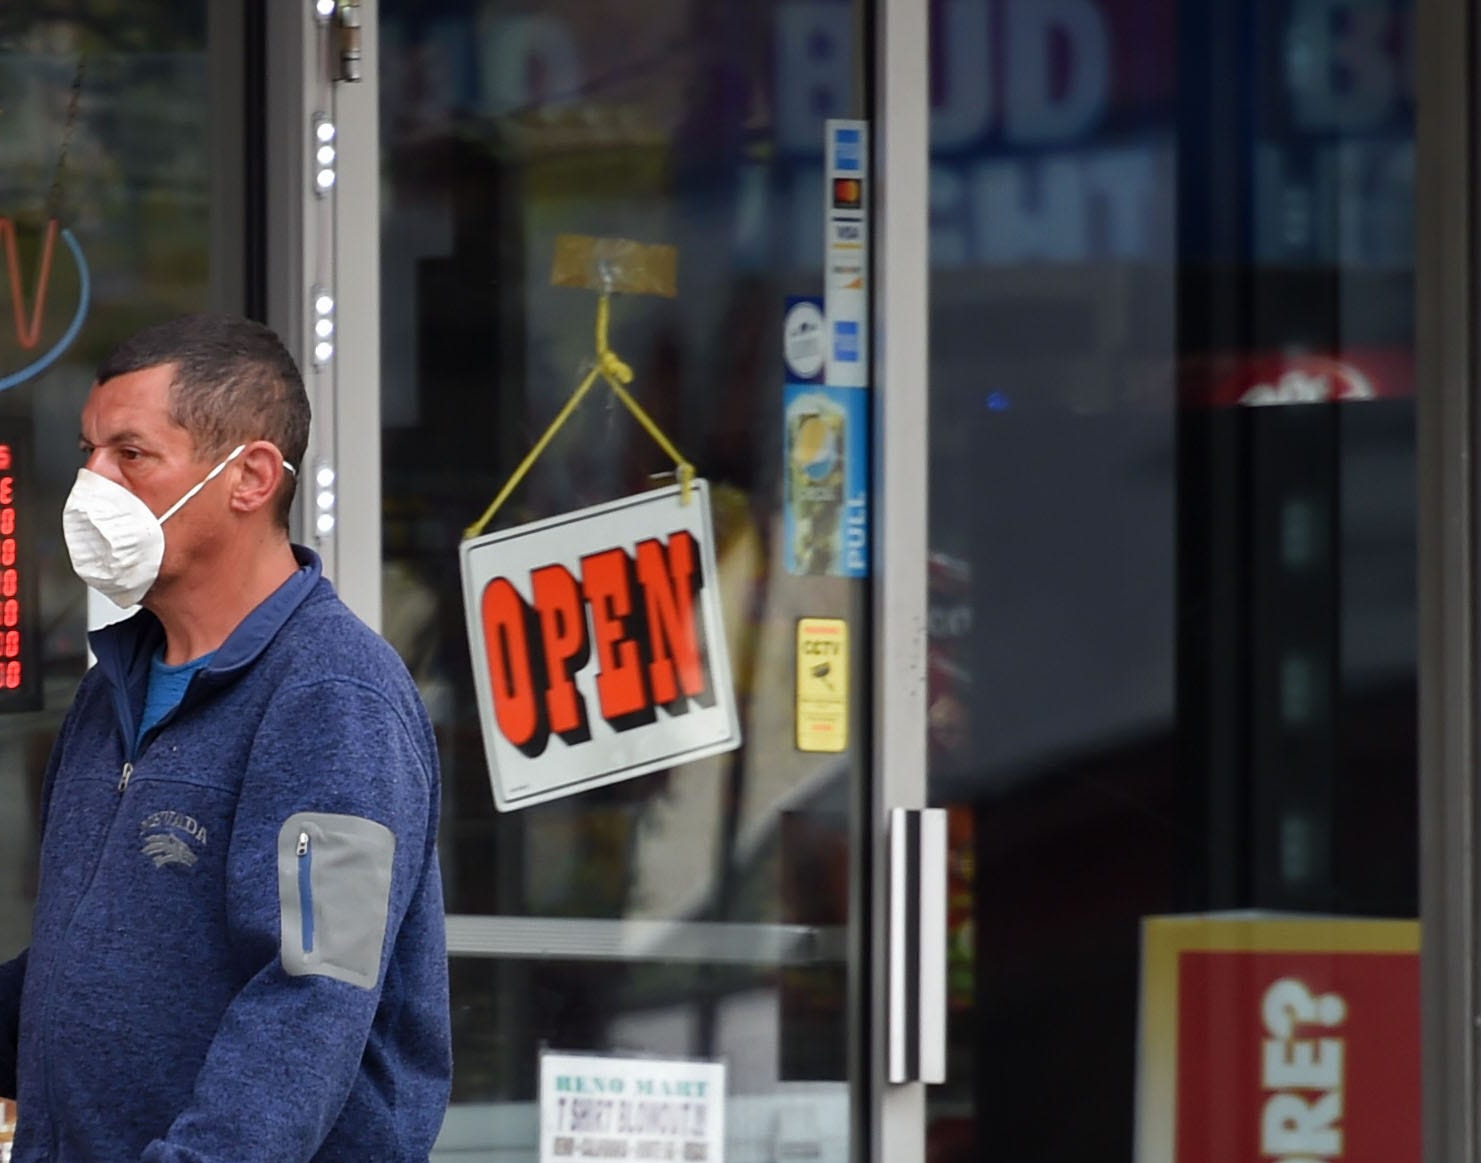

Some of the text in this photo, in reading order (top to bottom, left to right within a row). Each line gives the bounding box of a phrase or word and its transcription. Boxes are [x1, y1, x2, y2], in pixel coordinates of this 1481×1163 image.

[481, 529, 714, 756] OPEN
[803, 640, 841, 656] CCTV
[139, 809, 208, 846] NEVADA
[555, 1075, 709, 1097] RENO MART
